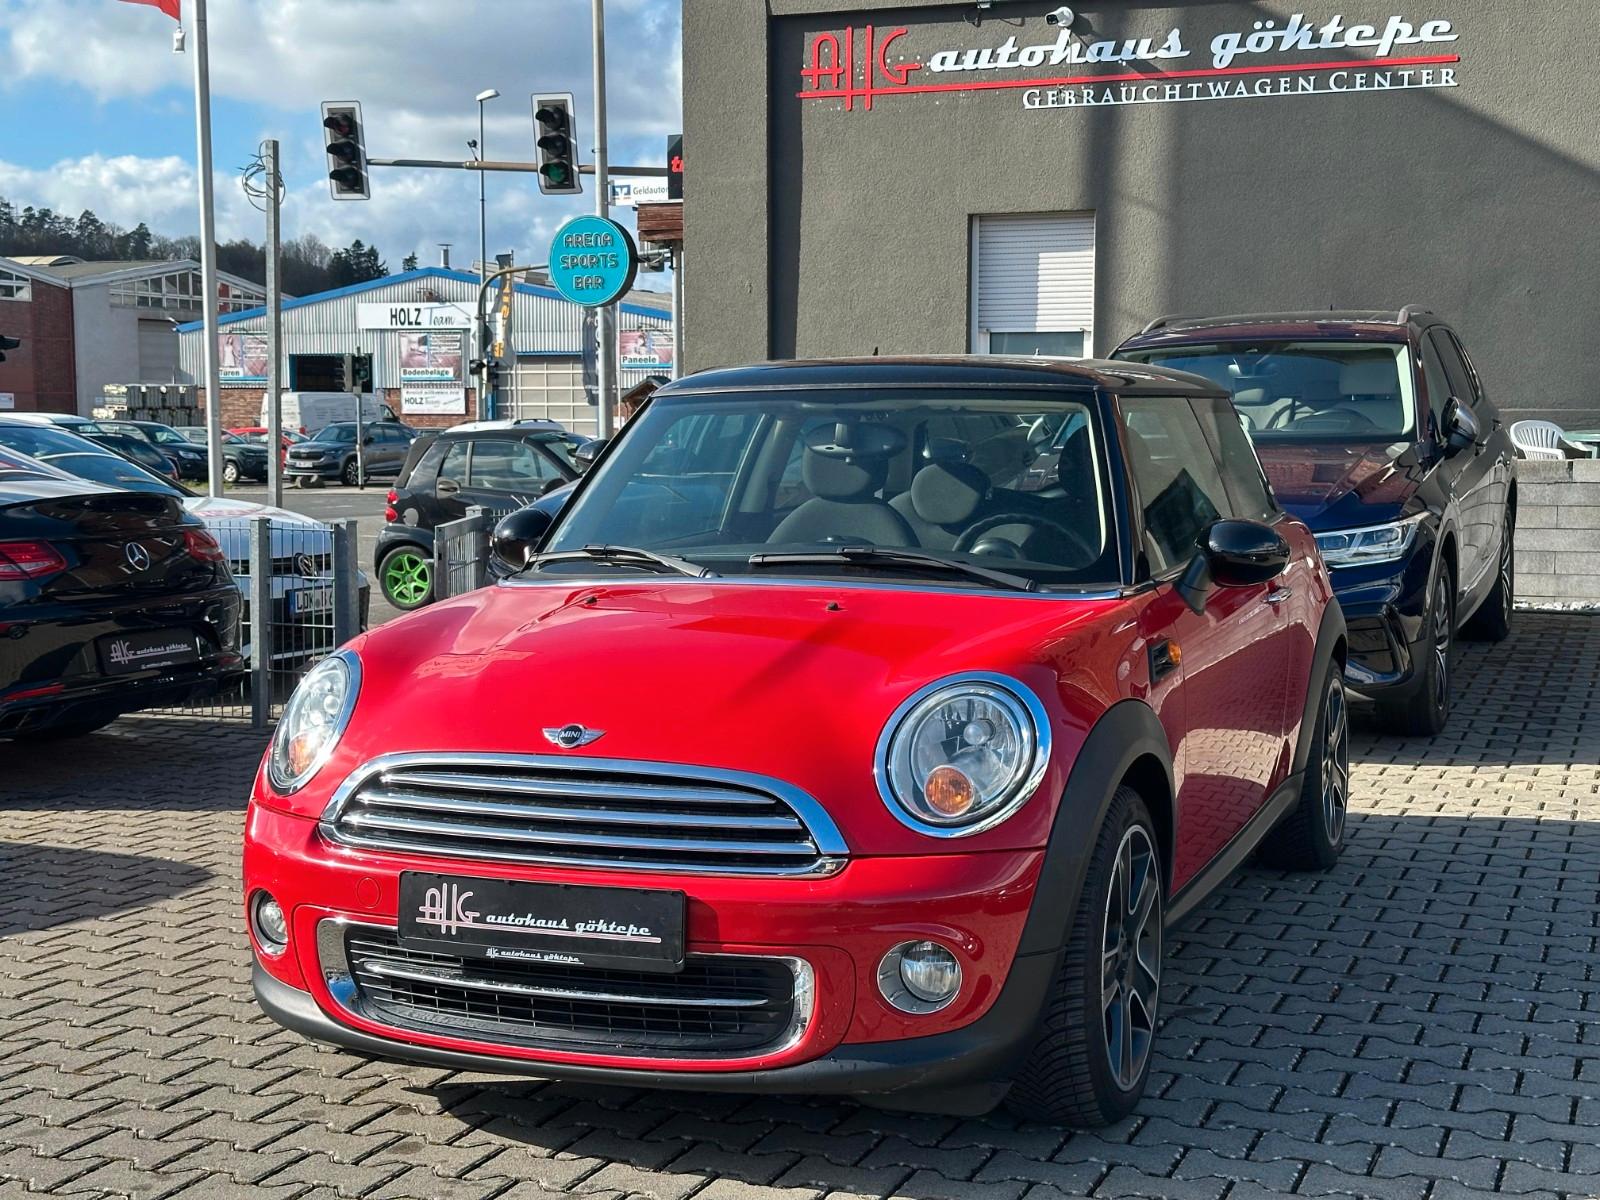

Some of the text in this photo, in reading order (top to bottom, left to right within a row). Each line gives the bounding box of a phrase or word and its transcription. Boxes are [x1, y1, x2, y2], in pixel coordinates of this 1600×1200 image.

[801, 13, 1460, 111] AHG autohaus göktepe
[1328, 68, 1459, 92] CENTER
[632, 186, 668, 195] Geldauto
[564, 232, 613, 248] ARENA
[559, 252, 619, 270] SPORTS
[573, 275, 605, 290] BAR
[390, 307, 422, 326] HOLZ
[622, 356, 657, 364] Paneele
[404, 397, 424, 405] HOLZ
[560, 730, 582, 738] MINI
[418, 883, 652, 937] AHG autohaus göktepe
[501, 950, 542, 959] autohaus
[543, 953, 580, 962] göktepe
